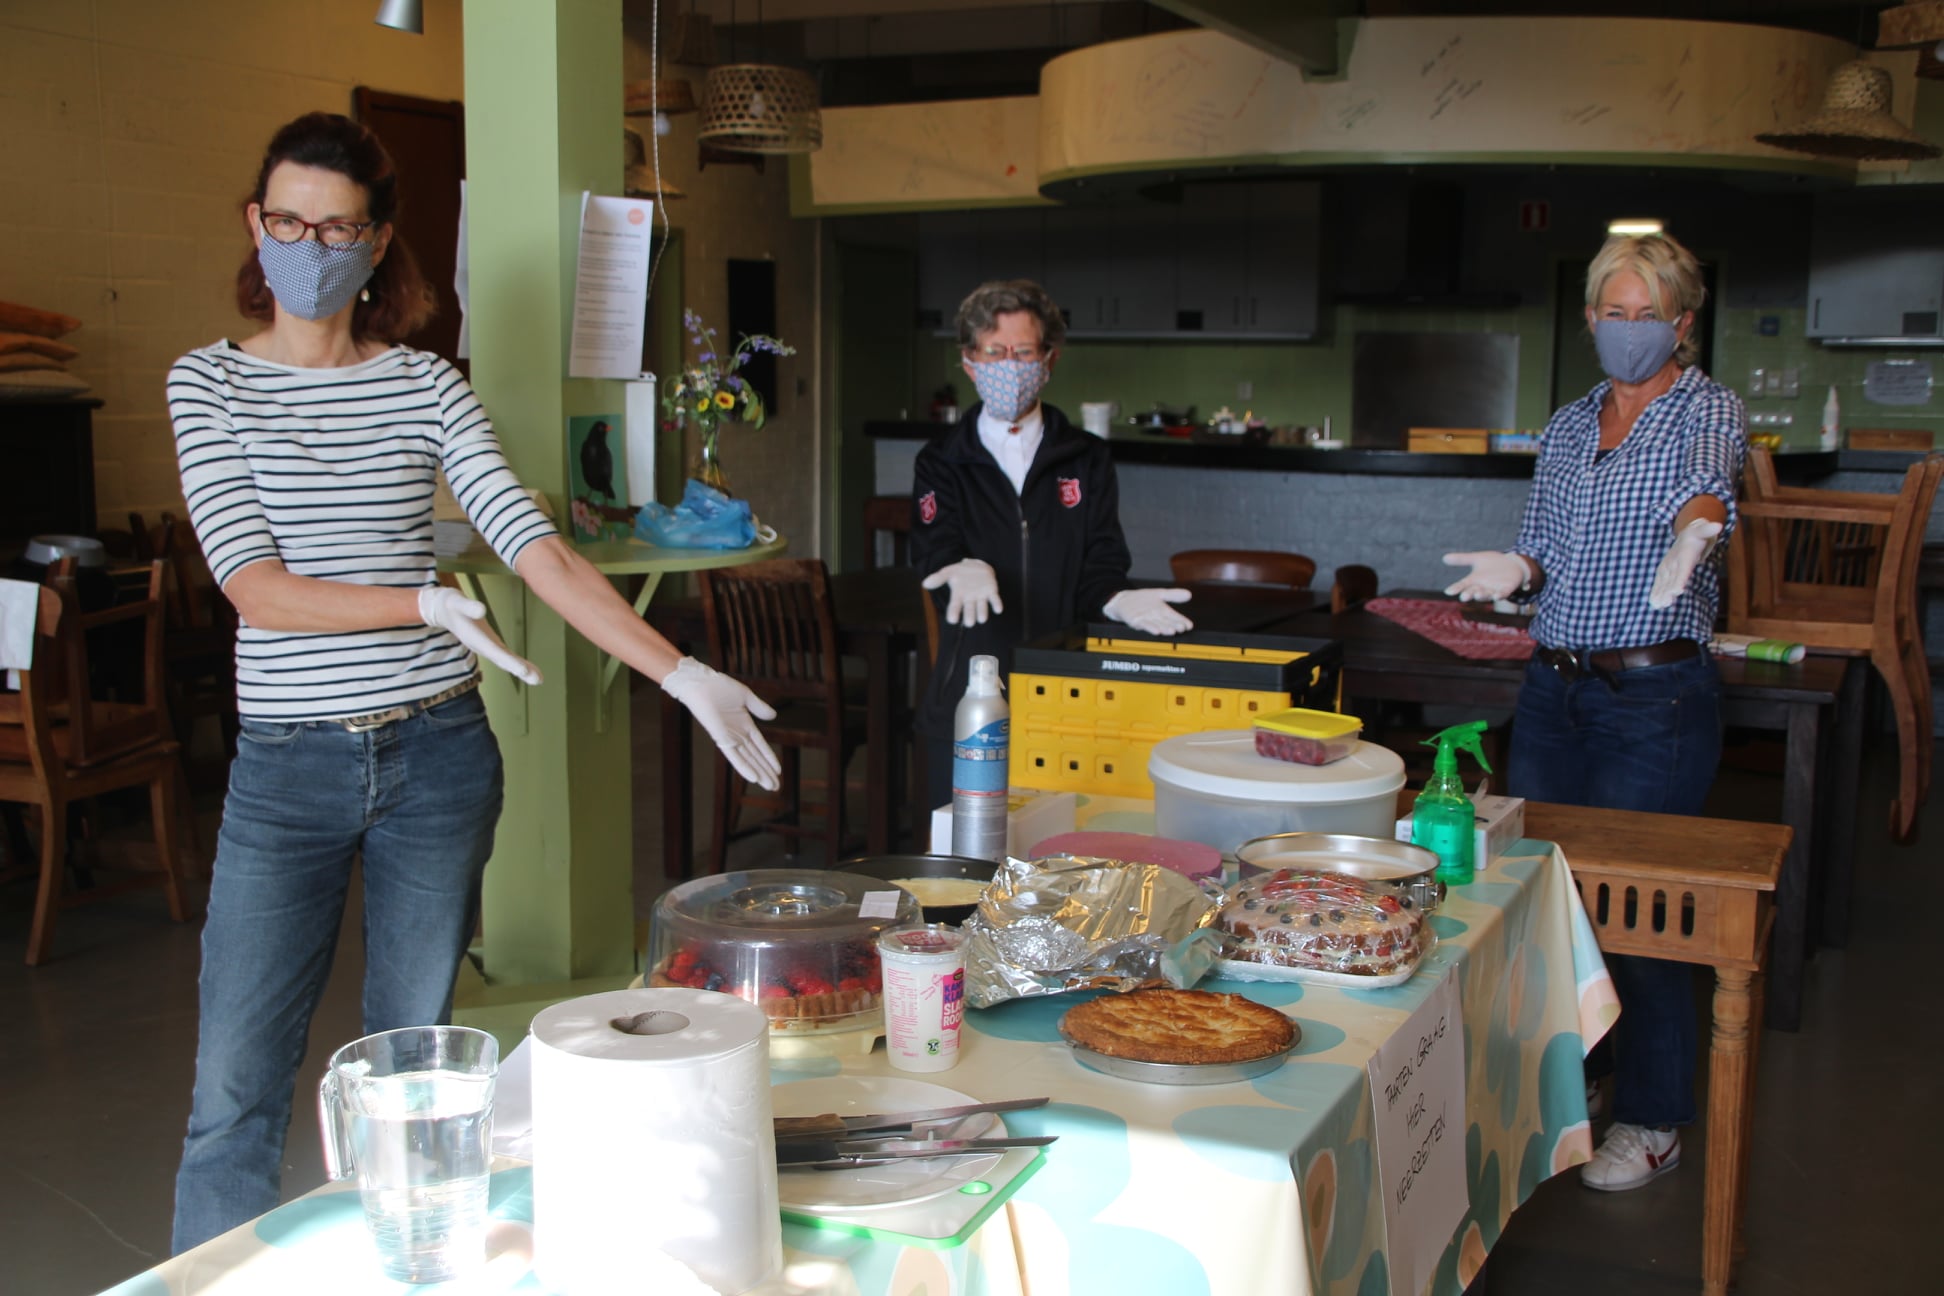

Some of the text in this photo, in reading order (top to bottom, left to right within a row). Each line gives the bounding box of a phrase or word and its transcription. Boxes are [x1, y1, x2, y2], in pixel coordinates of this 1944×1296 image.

[1102, 660, 1140, 672] JUMBO
[1385, 1016, 1446, 1111] TAARTEN GRAAG
[1396, 1100, 1447, 1213] NEERZETTEN
